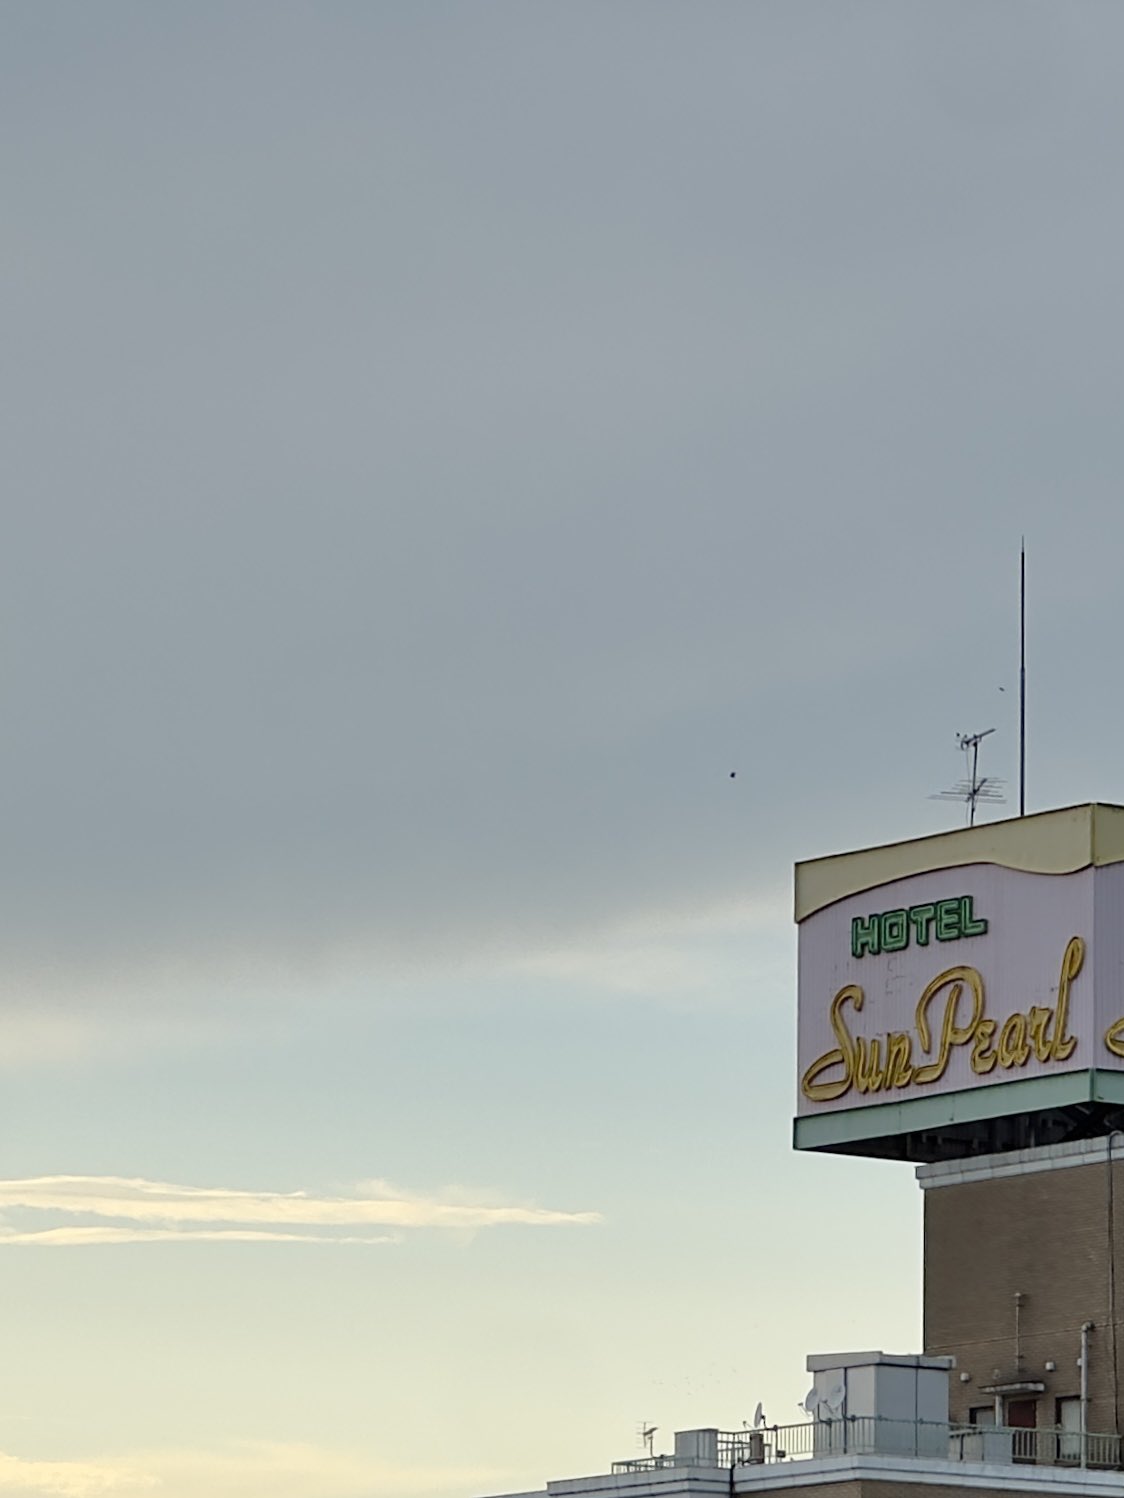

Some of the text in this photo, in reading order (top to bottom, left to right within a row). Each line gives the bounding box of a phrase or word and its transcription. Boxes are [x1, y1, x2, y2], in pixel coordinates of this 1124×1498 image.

[852, 895, 988, 958] HOTEL
[802, 936, 1085, 1101] Sun Pearl
